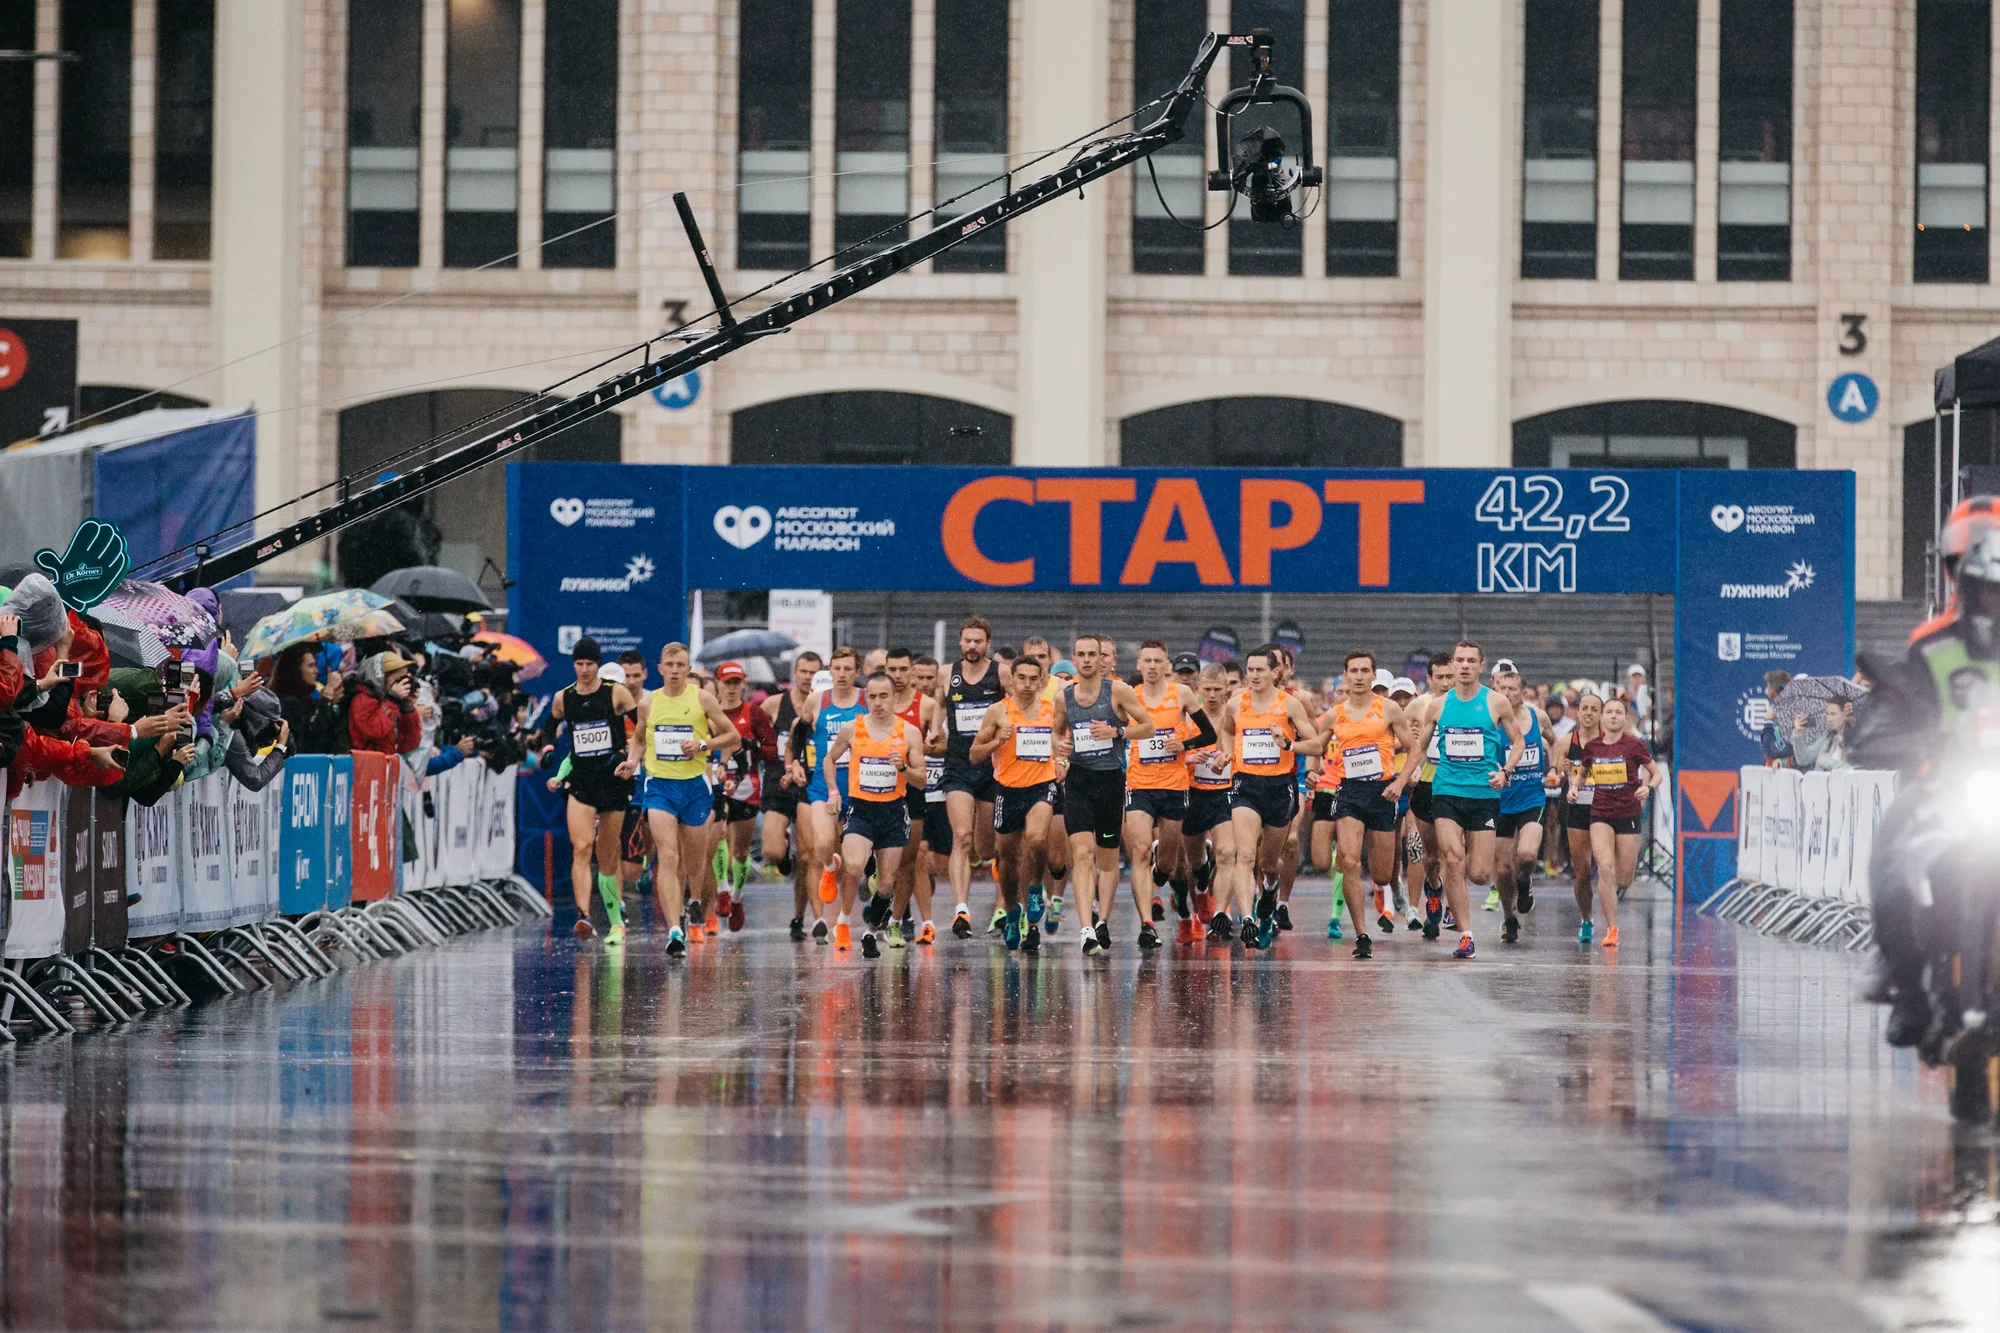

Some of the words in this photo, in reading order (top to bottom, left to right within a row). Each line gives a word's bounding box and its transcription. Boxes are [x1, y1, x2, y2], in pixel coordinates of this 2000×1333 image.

[1839, 314, 1867, 355] 3
[1475, 475, 1630, 539] 42,2
[1746, 513, 1816, 525] МОСКОВСКИЙ
[774, 519, 896, 536] МОСКОВСКИЙ
[941, 476, 1424, 587] СТАРТ
[1746, 524, 1796, 534] МАРАФОН
[774, 536, 861, 551] МАРАФОН
[1477, 543, 1576, 592] КМ
[1720, 584, 1790, 599] ЛУЖНИКИ
[576, 731, 608, 744] 15007
[1149, 739, 1164, 751] 33
[1525, 750, 1536, 761] 17
